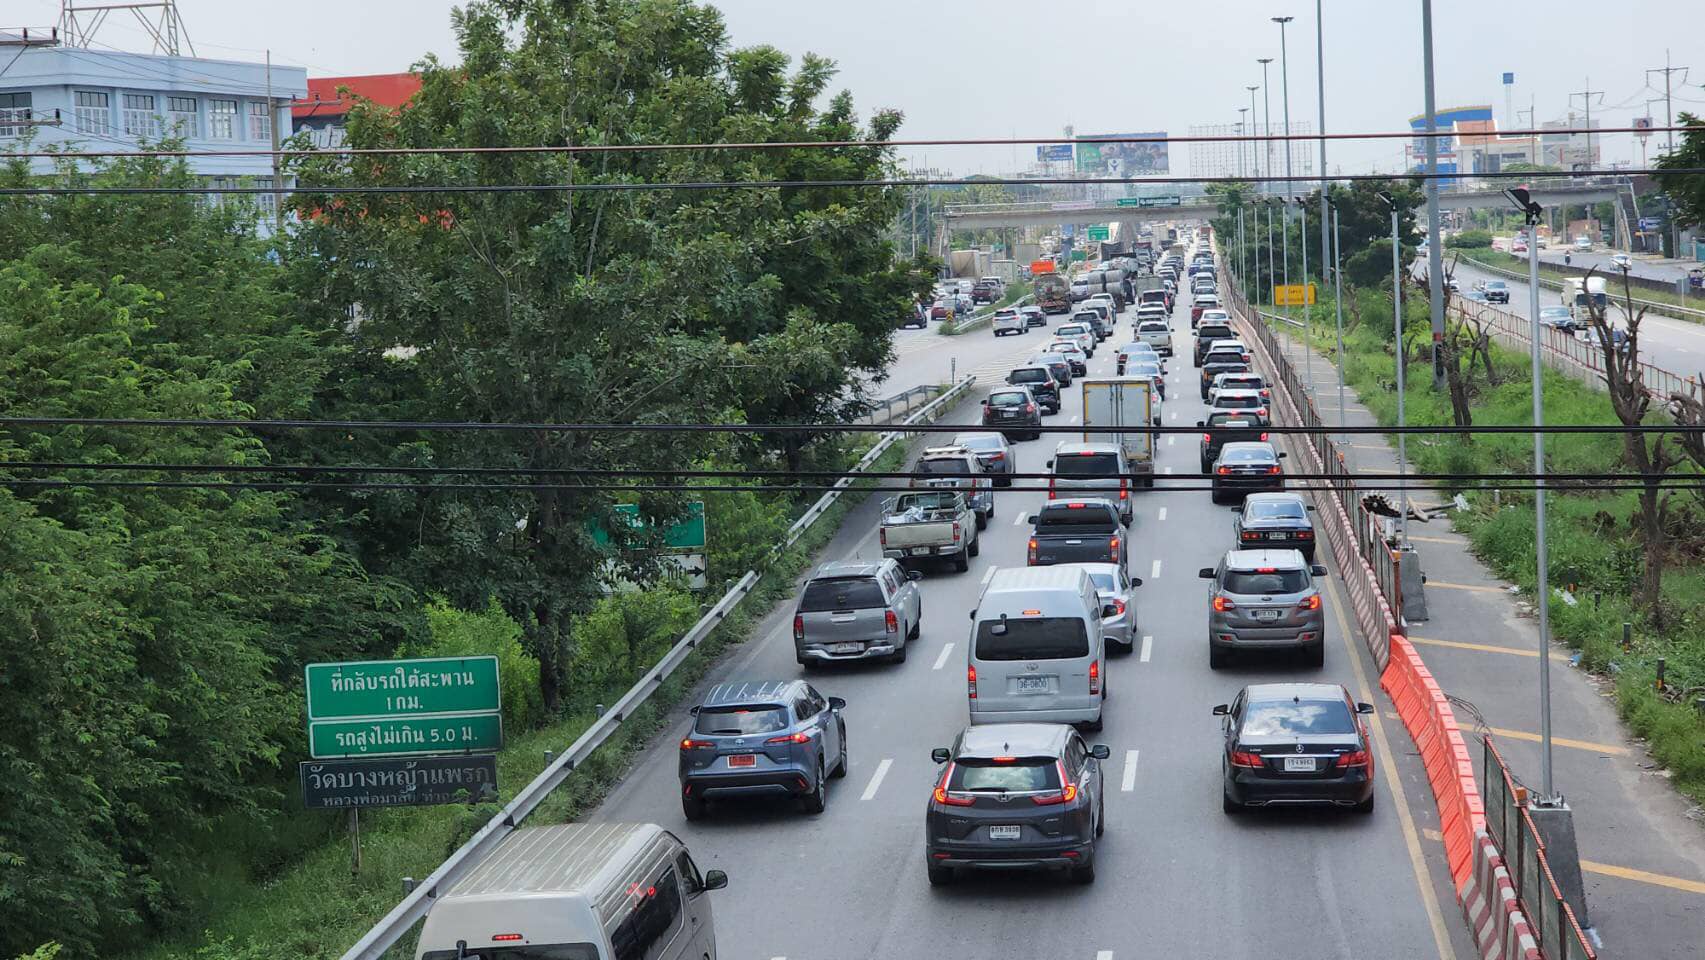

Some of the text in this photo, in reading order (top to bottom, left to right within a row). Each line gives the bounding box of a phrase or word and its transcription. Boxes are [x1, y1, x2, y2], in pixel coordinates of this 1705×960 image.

[331, 666, 474, 692] ที่กลับรถใต้สะพาน
[396, 695, 424, 710] กม.
[335, 725, 478, 752] รถสูงไม่เกิน 5.0 ม.
[308, 761, 490, 792] วัดบางหญ้าแพรก
